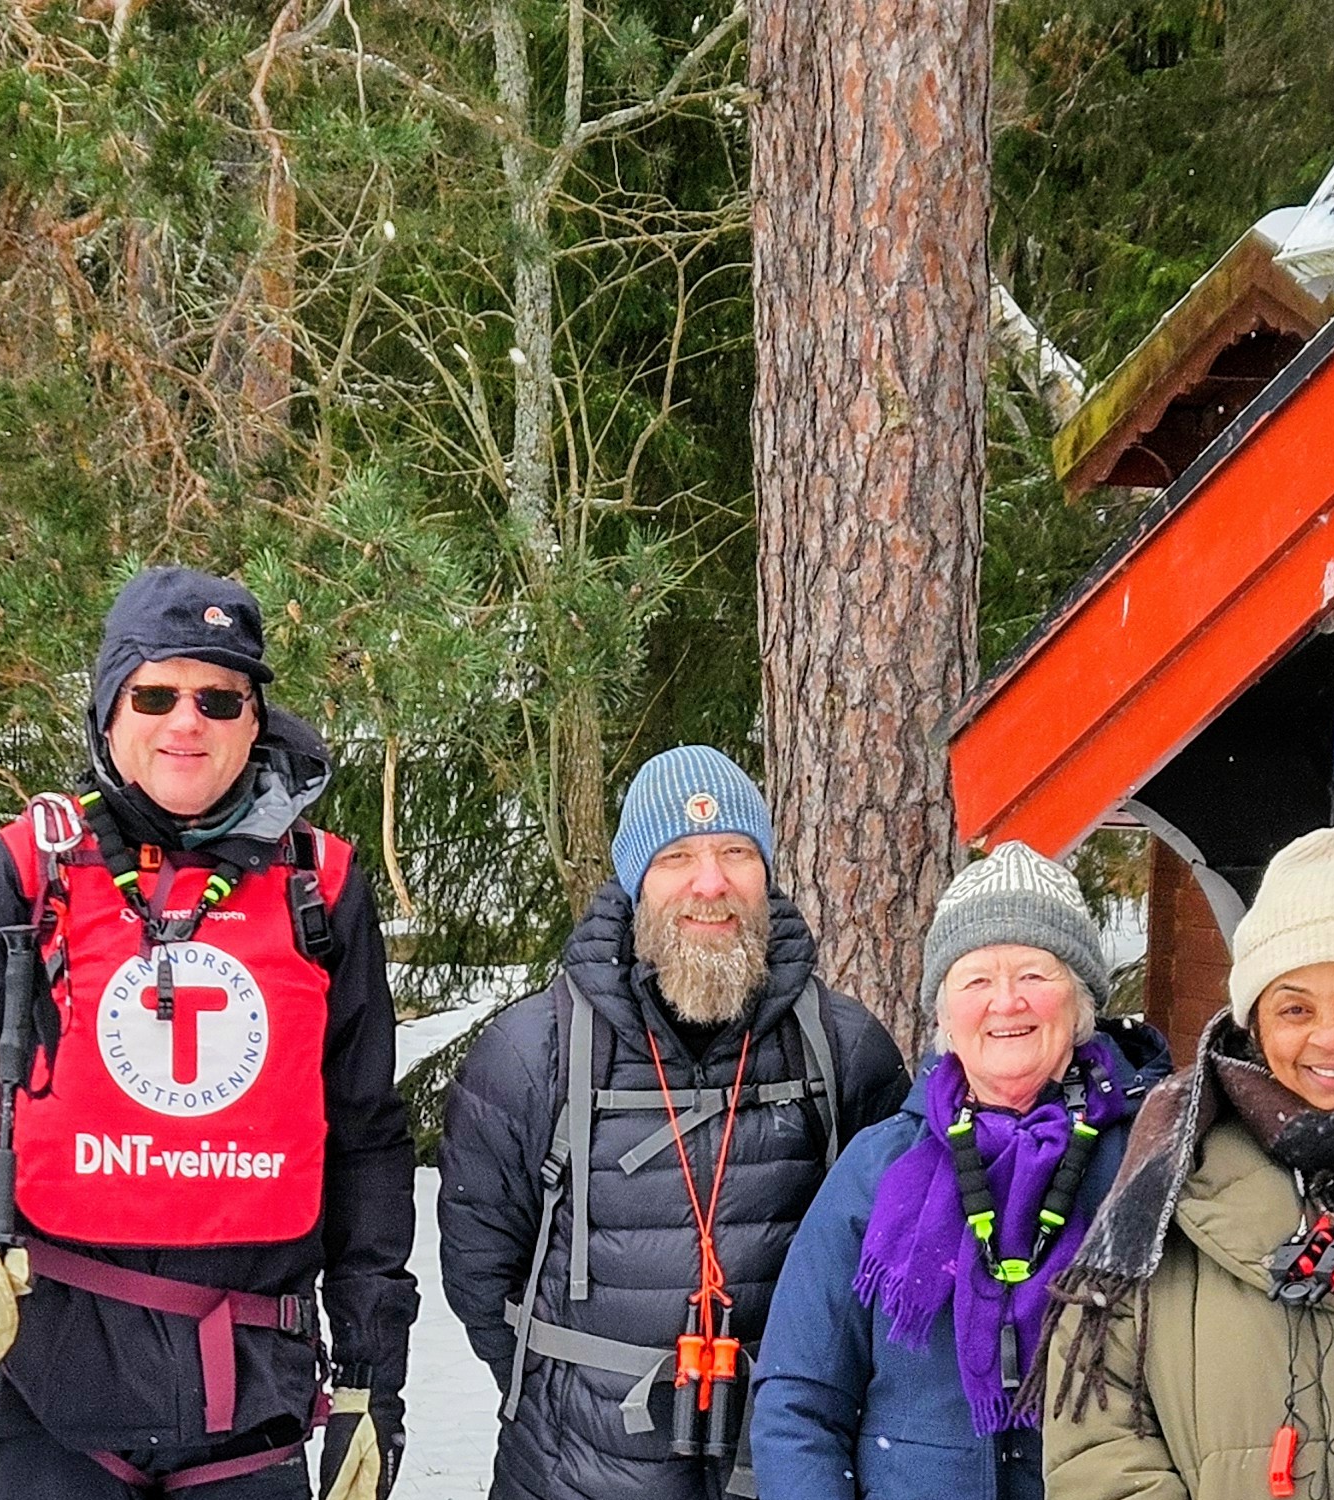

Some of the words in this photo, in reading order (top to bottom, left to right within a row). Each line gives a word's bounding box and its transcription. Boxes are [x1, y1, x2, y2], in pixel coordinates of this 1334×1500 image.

[694, 800, 708, 816] T
[113, 960, 155, 1001] DEN
[140, 985, 229, 1085] T
[106, 1029, 263, 1108] TURISTFORENING
[75, 1132, 286, 1179] DNT-veiviser
